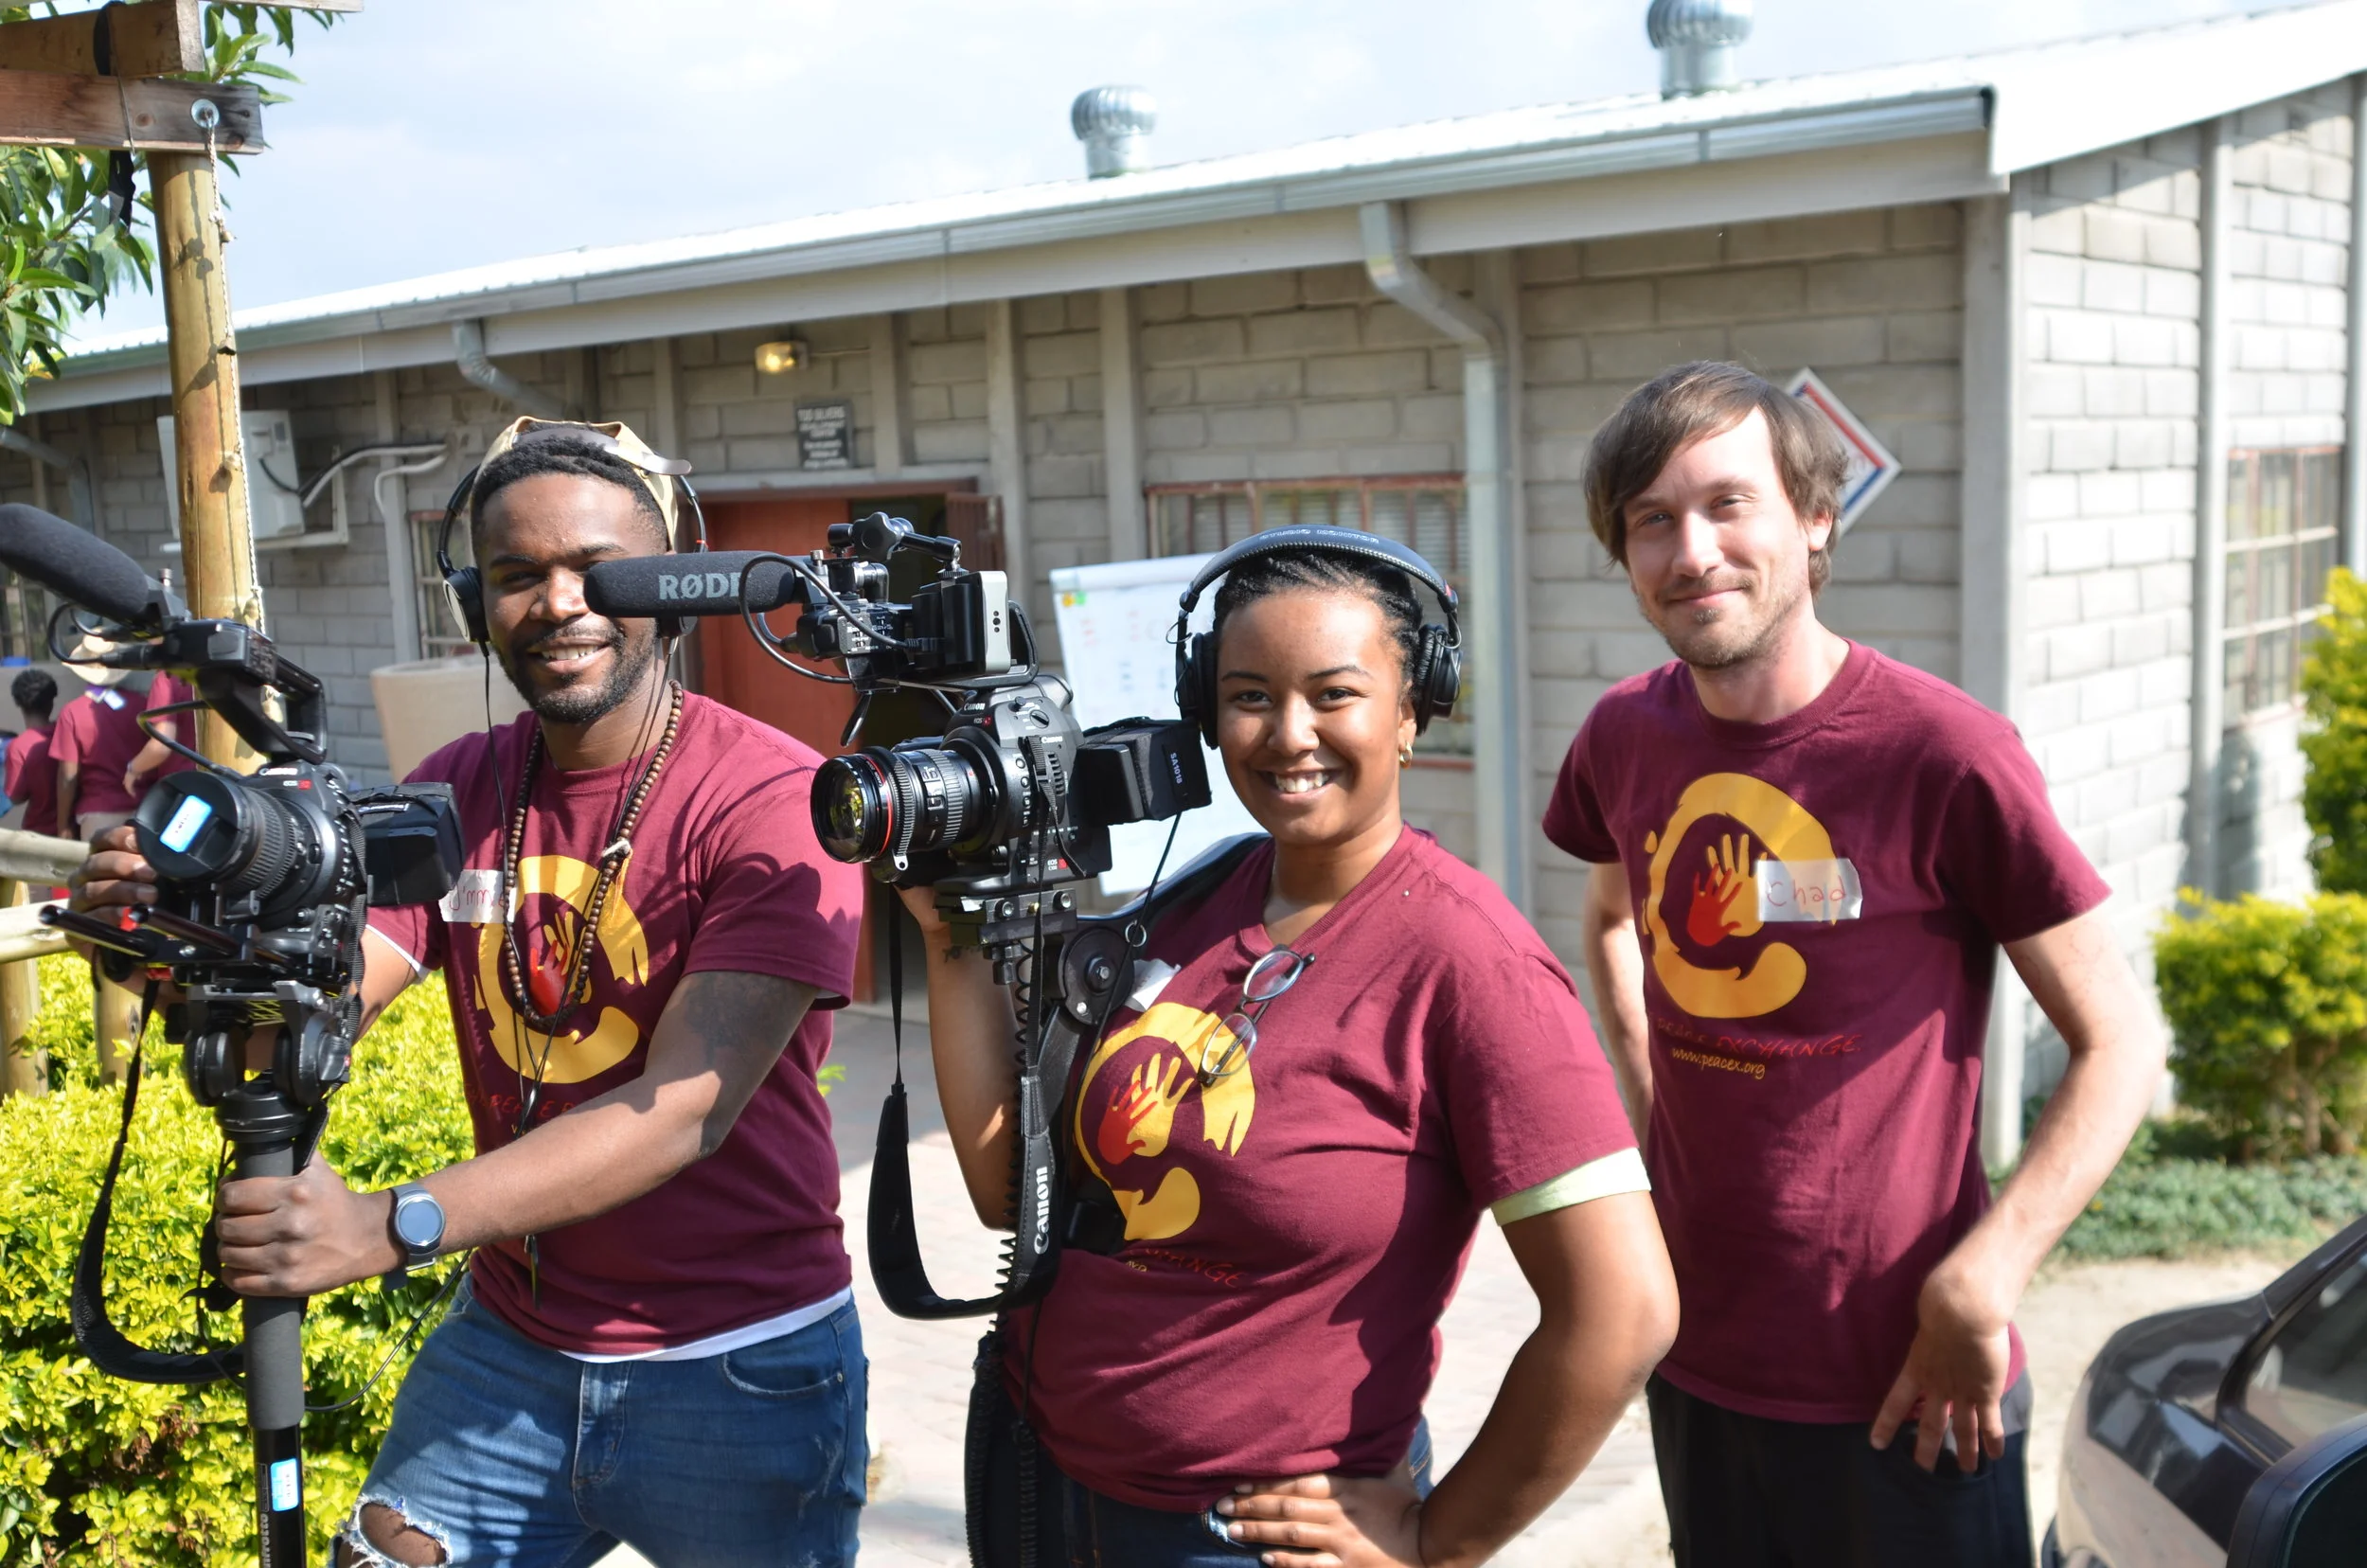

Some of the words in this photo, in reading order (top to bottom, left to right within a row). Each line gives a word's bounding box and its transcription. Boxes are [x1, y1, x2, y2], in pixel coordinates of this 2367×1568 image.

[1170, 753, 1183, 784] SA1018
[1767, 875, 1846, 906] Chad
[1671, 1047, 1766, 1079] www.peacex.org
[1034, 1167, 1049, 1255] Canon
